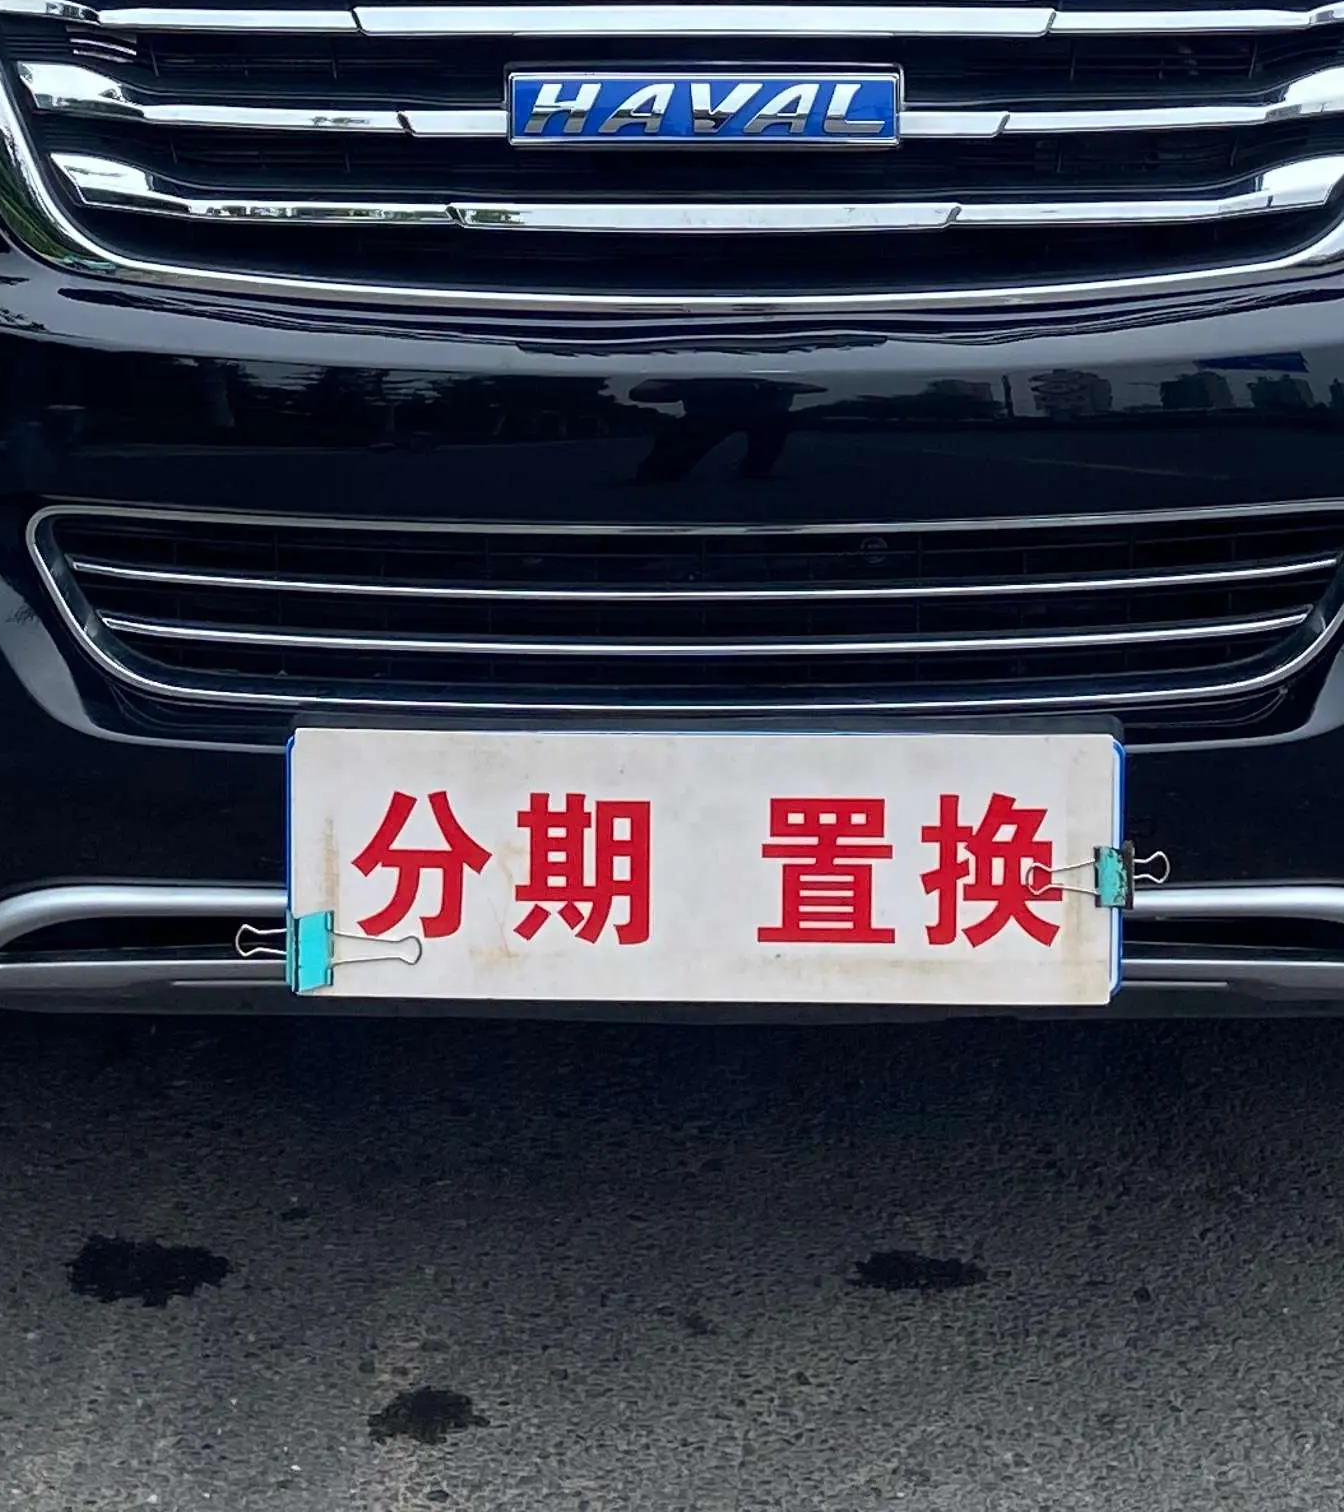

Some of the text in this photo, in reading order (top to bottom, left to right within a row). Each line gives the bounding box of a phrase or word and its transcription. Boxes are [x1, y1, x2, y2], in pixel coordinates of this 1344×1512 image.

[523, 83, 885, 134] HAVAL
[353, 791, 1064, 948] 分期 置换
